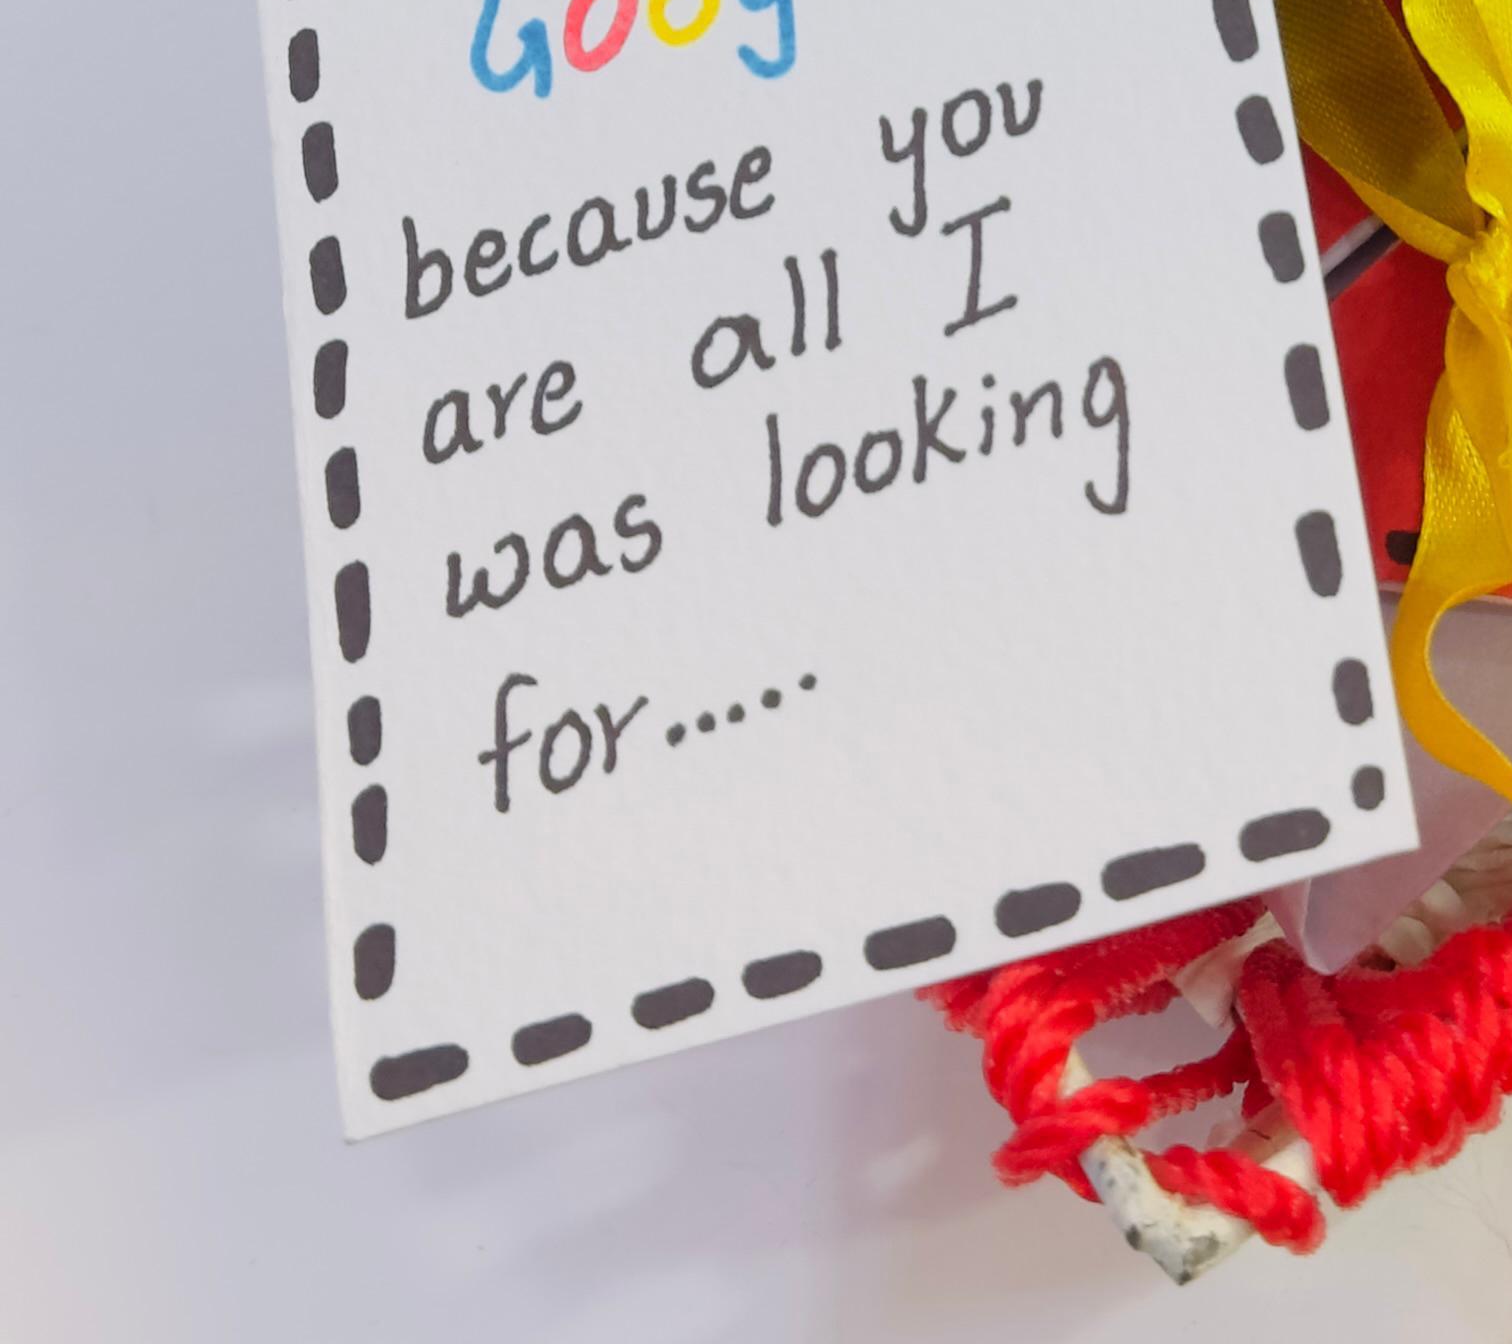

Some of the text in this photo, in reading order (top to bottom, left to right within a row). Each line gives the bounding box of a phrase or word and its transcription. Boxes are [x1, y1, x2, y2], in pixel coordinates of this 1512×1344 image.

[403, 80, 1042, 319] because you
[423, 197, 1017, 464] are all I
[447, 358, 1129, 617] was looking
